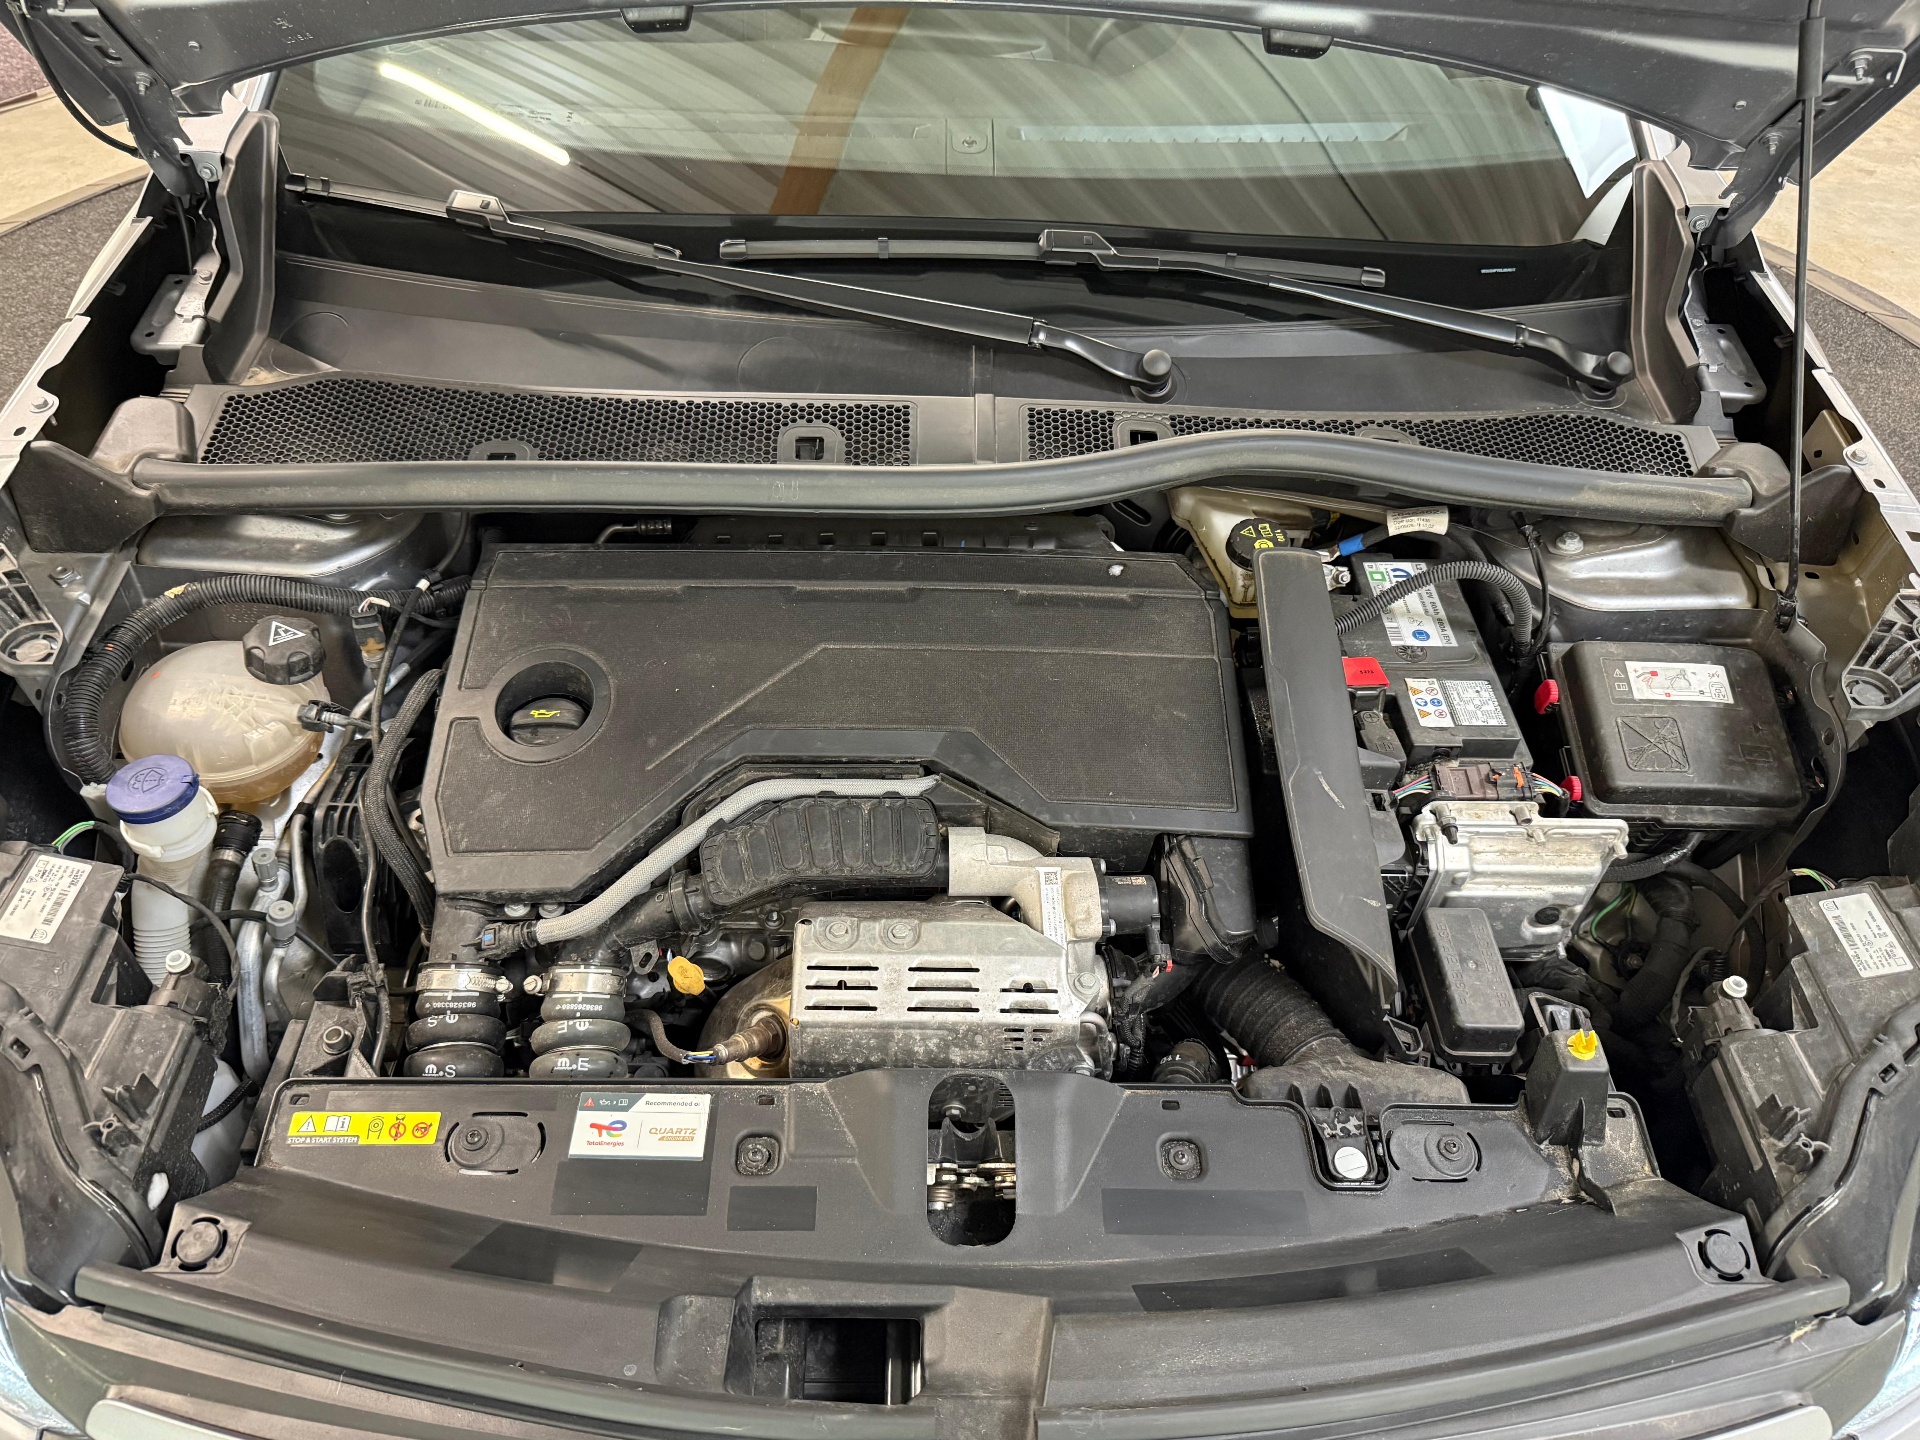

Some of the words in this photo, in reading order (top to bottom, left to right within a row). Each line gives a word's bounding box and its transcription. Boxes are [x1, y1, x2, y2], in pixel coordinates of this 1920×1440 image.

[645, 1100, 693, 1108] Recommended
[648, 1127, 698, 1136] QUARTZ
[586, 1140, 625, 1148] TotalEnergies
